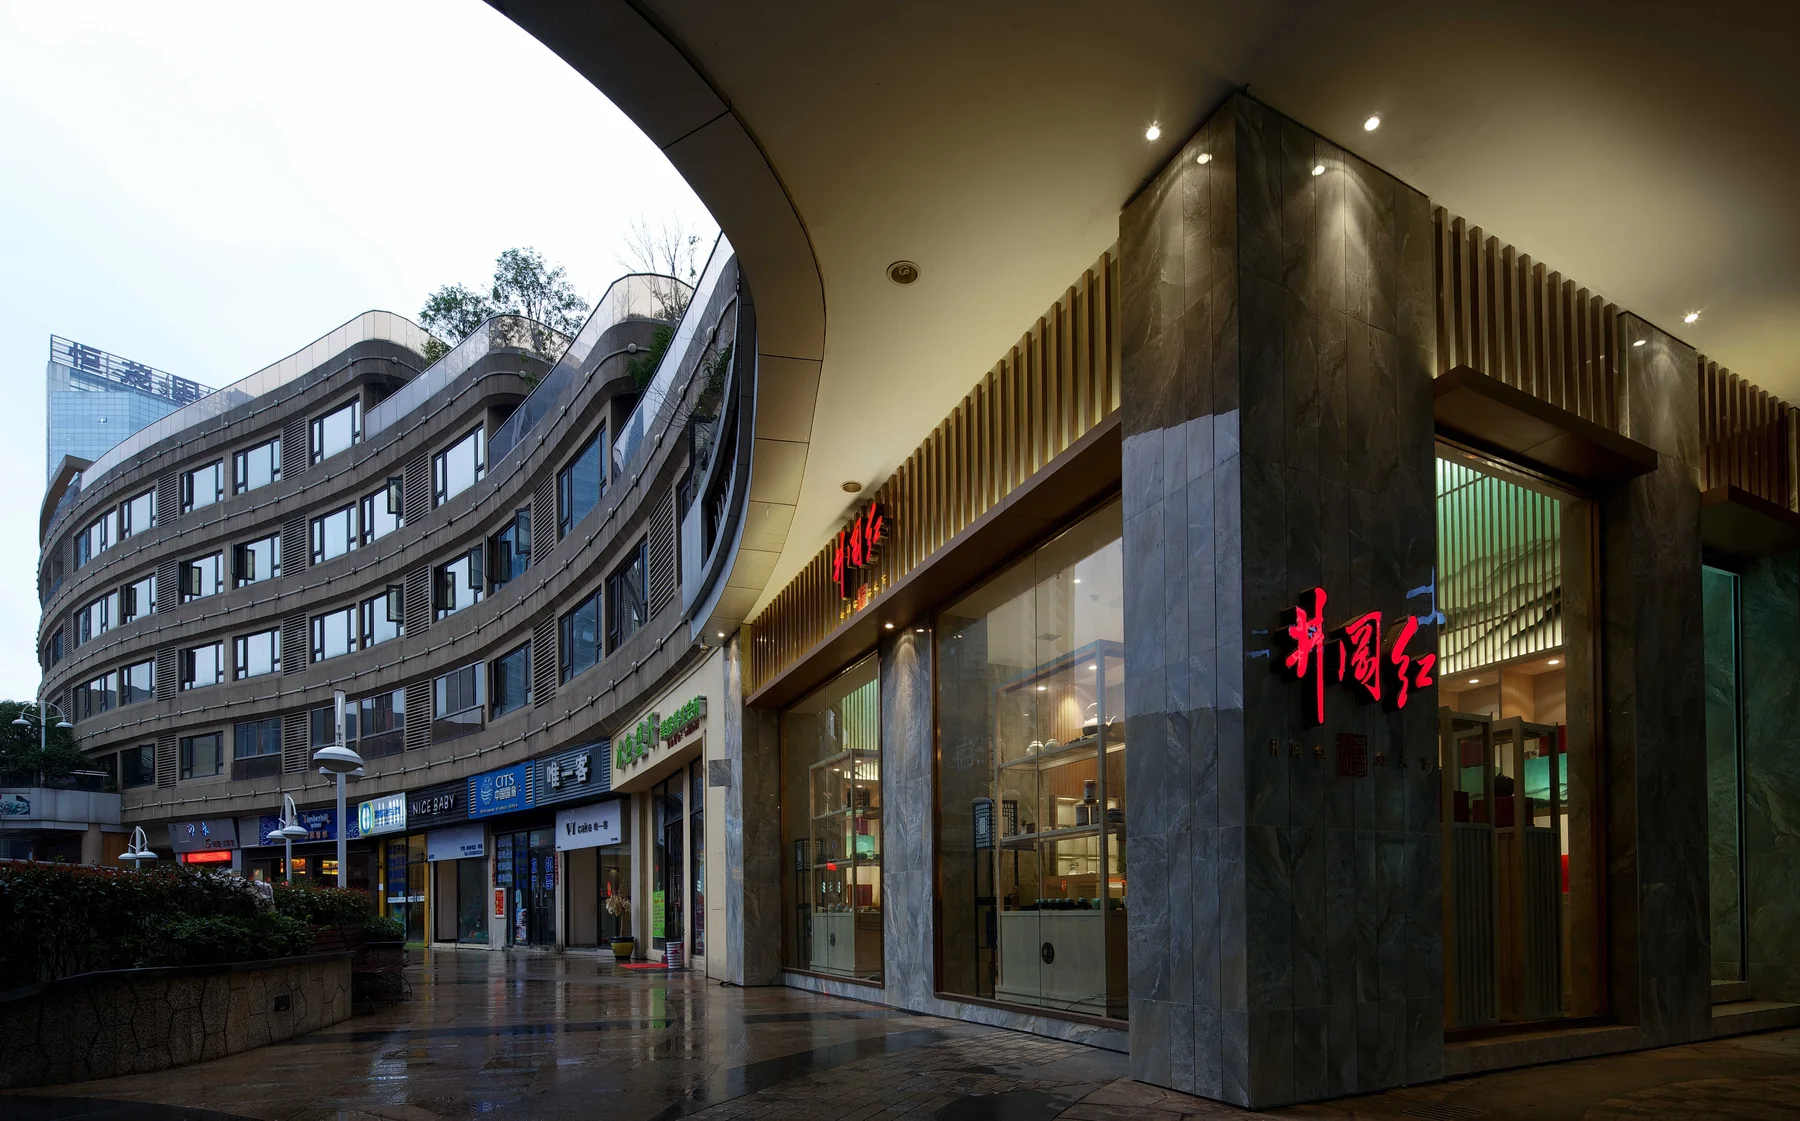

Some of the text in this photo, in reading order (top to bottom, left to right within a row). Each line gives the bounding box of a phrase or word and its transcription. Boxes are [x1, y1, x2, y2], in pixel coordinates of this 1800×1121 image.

[546, 753, 588, 788] 唯一客
[495, 772, 515, 788] CITS
[412, 799, 431, 815] NICE
[433, 794, 455, 812] BABY
[577, 822, 593, 835] cake
